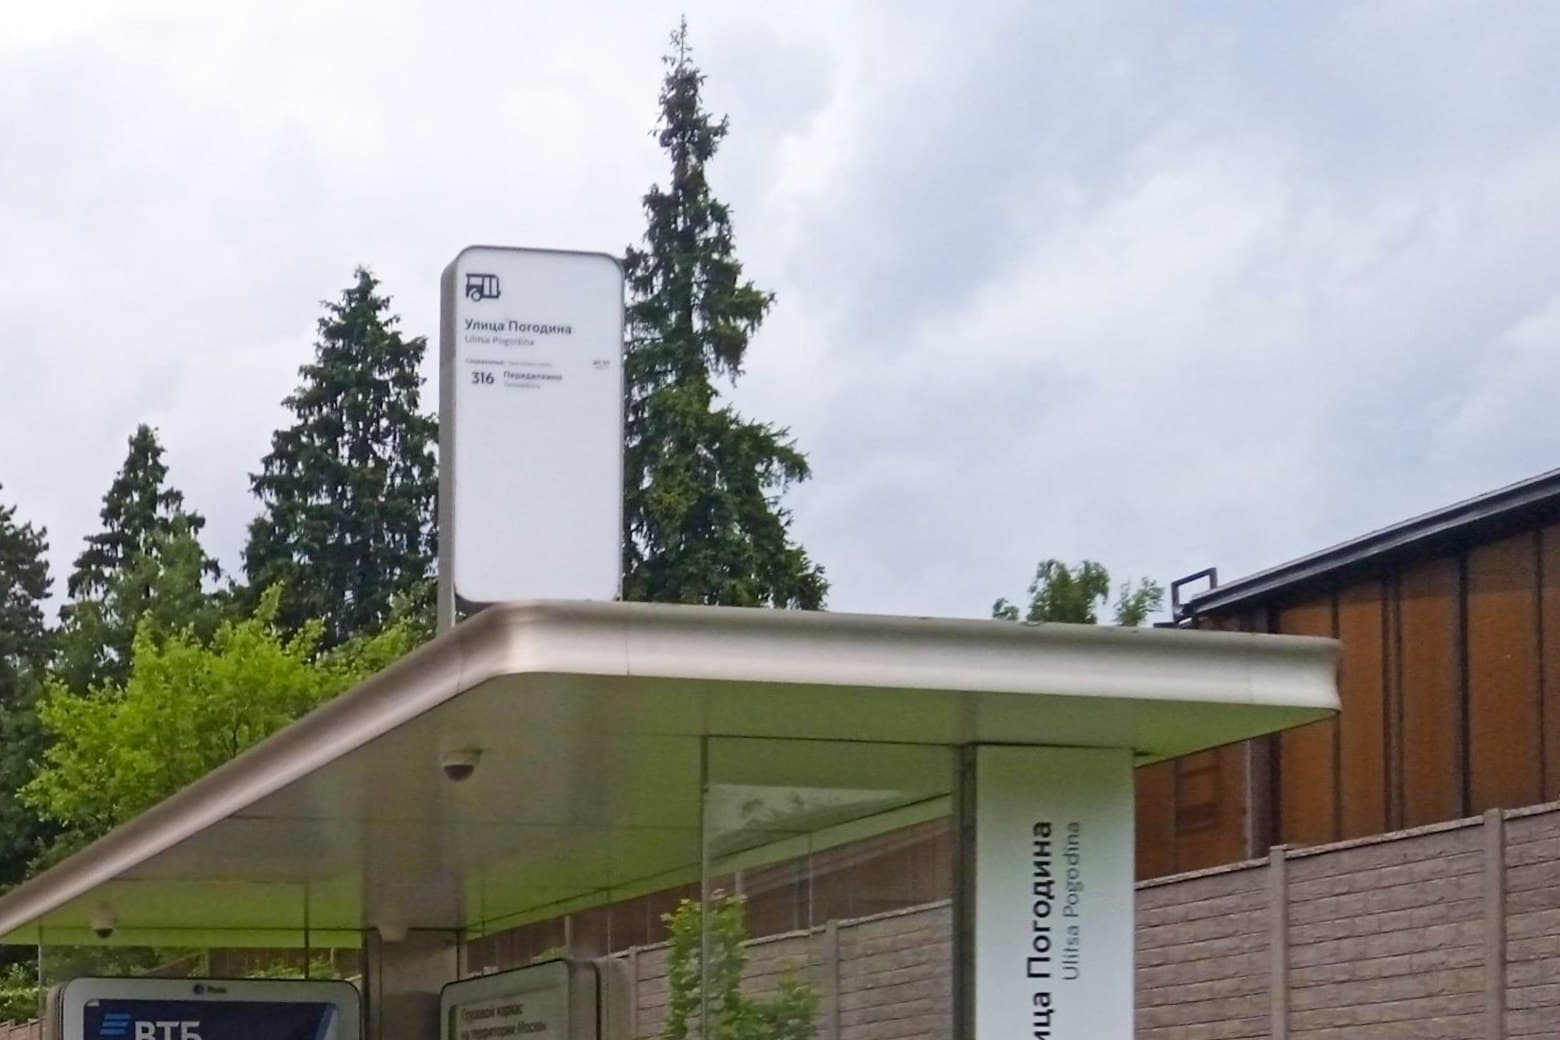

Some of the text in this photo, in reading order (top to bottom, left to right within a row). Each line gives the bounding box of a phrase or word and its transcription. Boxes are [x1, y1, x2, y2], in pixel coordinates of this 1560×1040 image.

[465, 318, 573, 335] Улица Погодина
[471, 371, 495, 385] 316
[1026, 821, 1055, 978] Погодина
[1061, 821, 1085, 980] Ulitsa Pogodina
